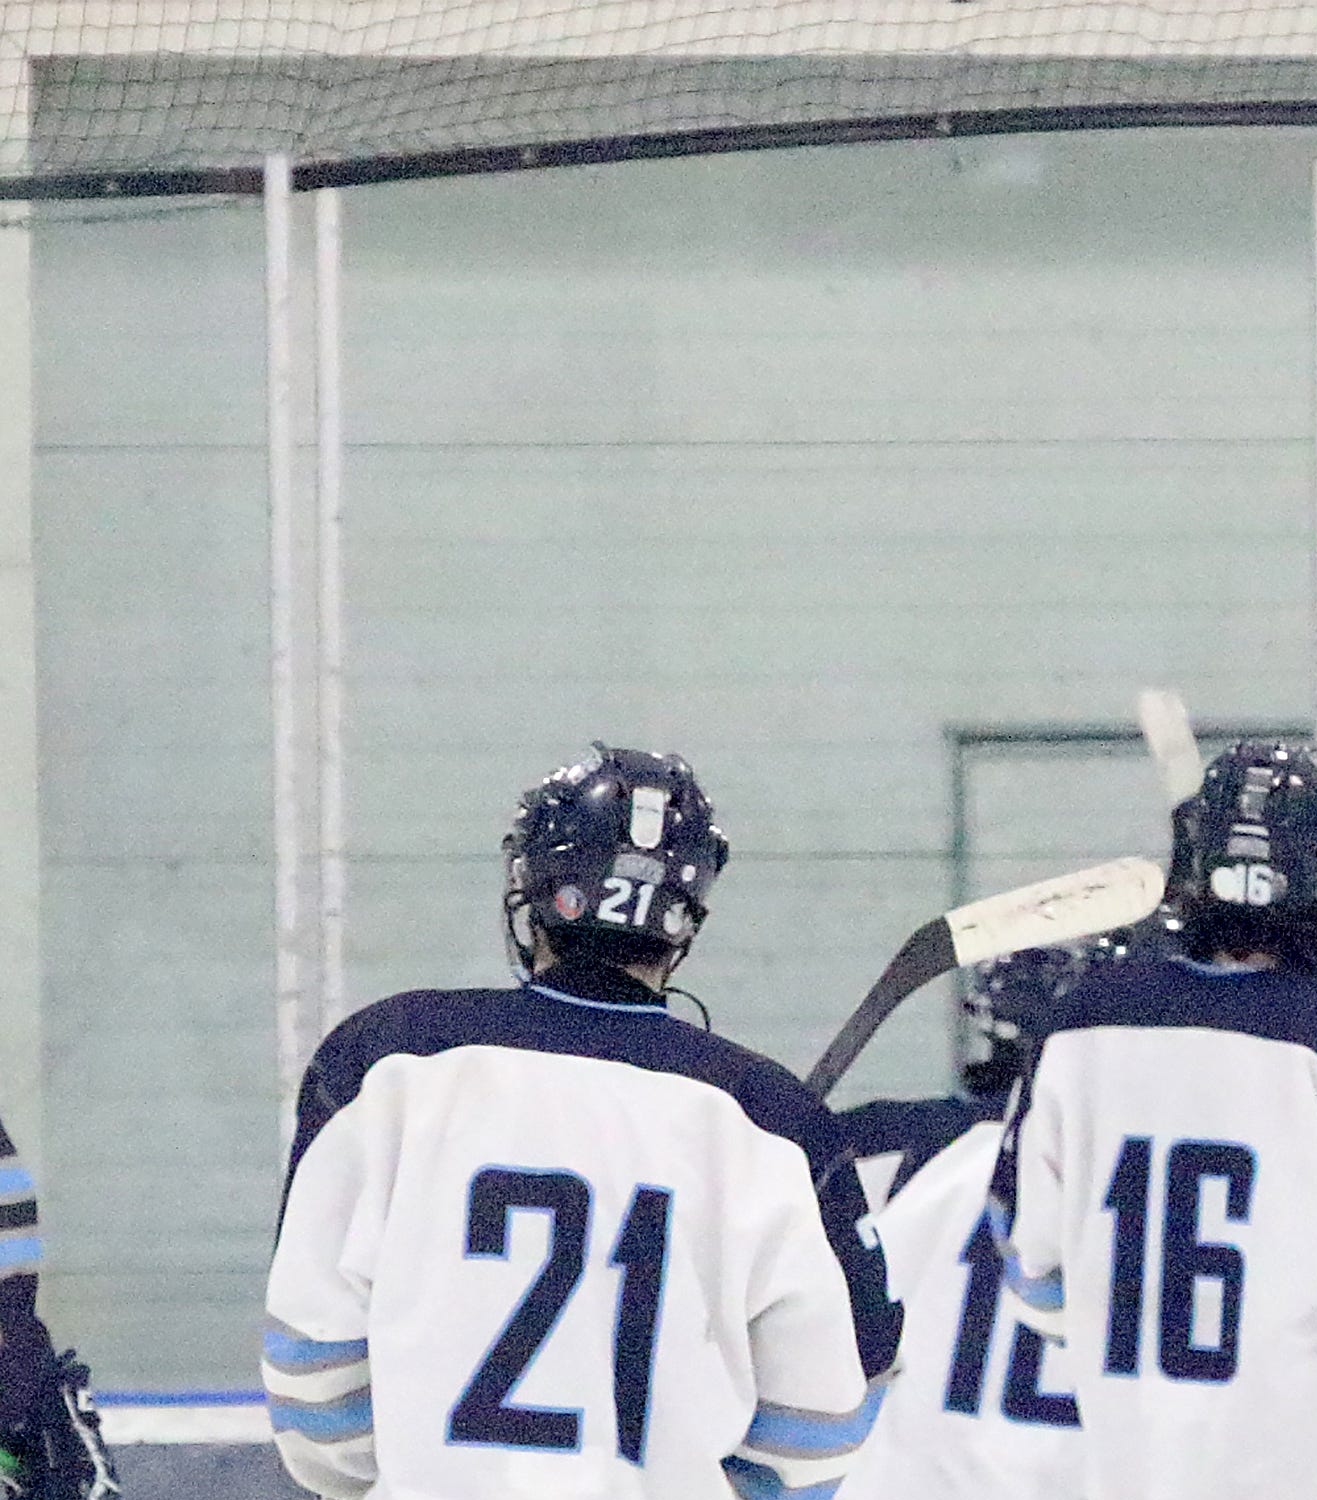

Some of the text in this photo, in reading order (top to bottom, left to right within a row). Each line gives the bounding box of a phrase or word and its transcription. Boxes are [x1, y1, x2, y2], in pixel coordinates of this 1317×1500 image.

[596, 876, 656, 926] 21
[443, 1162, 676, 1467] 21
[1101, 1133, 1260, 1387] 16
